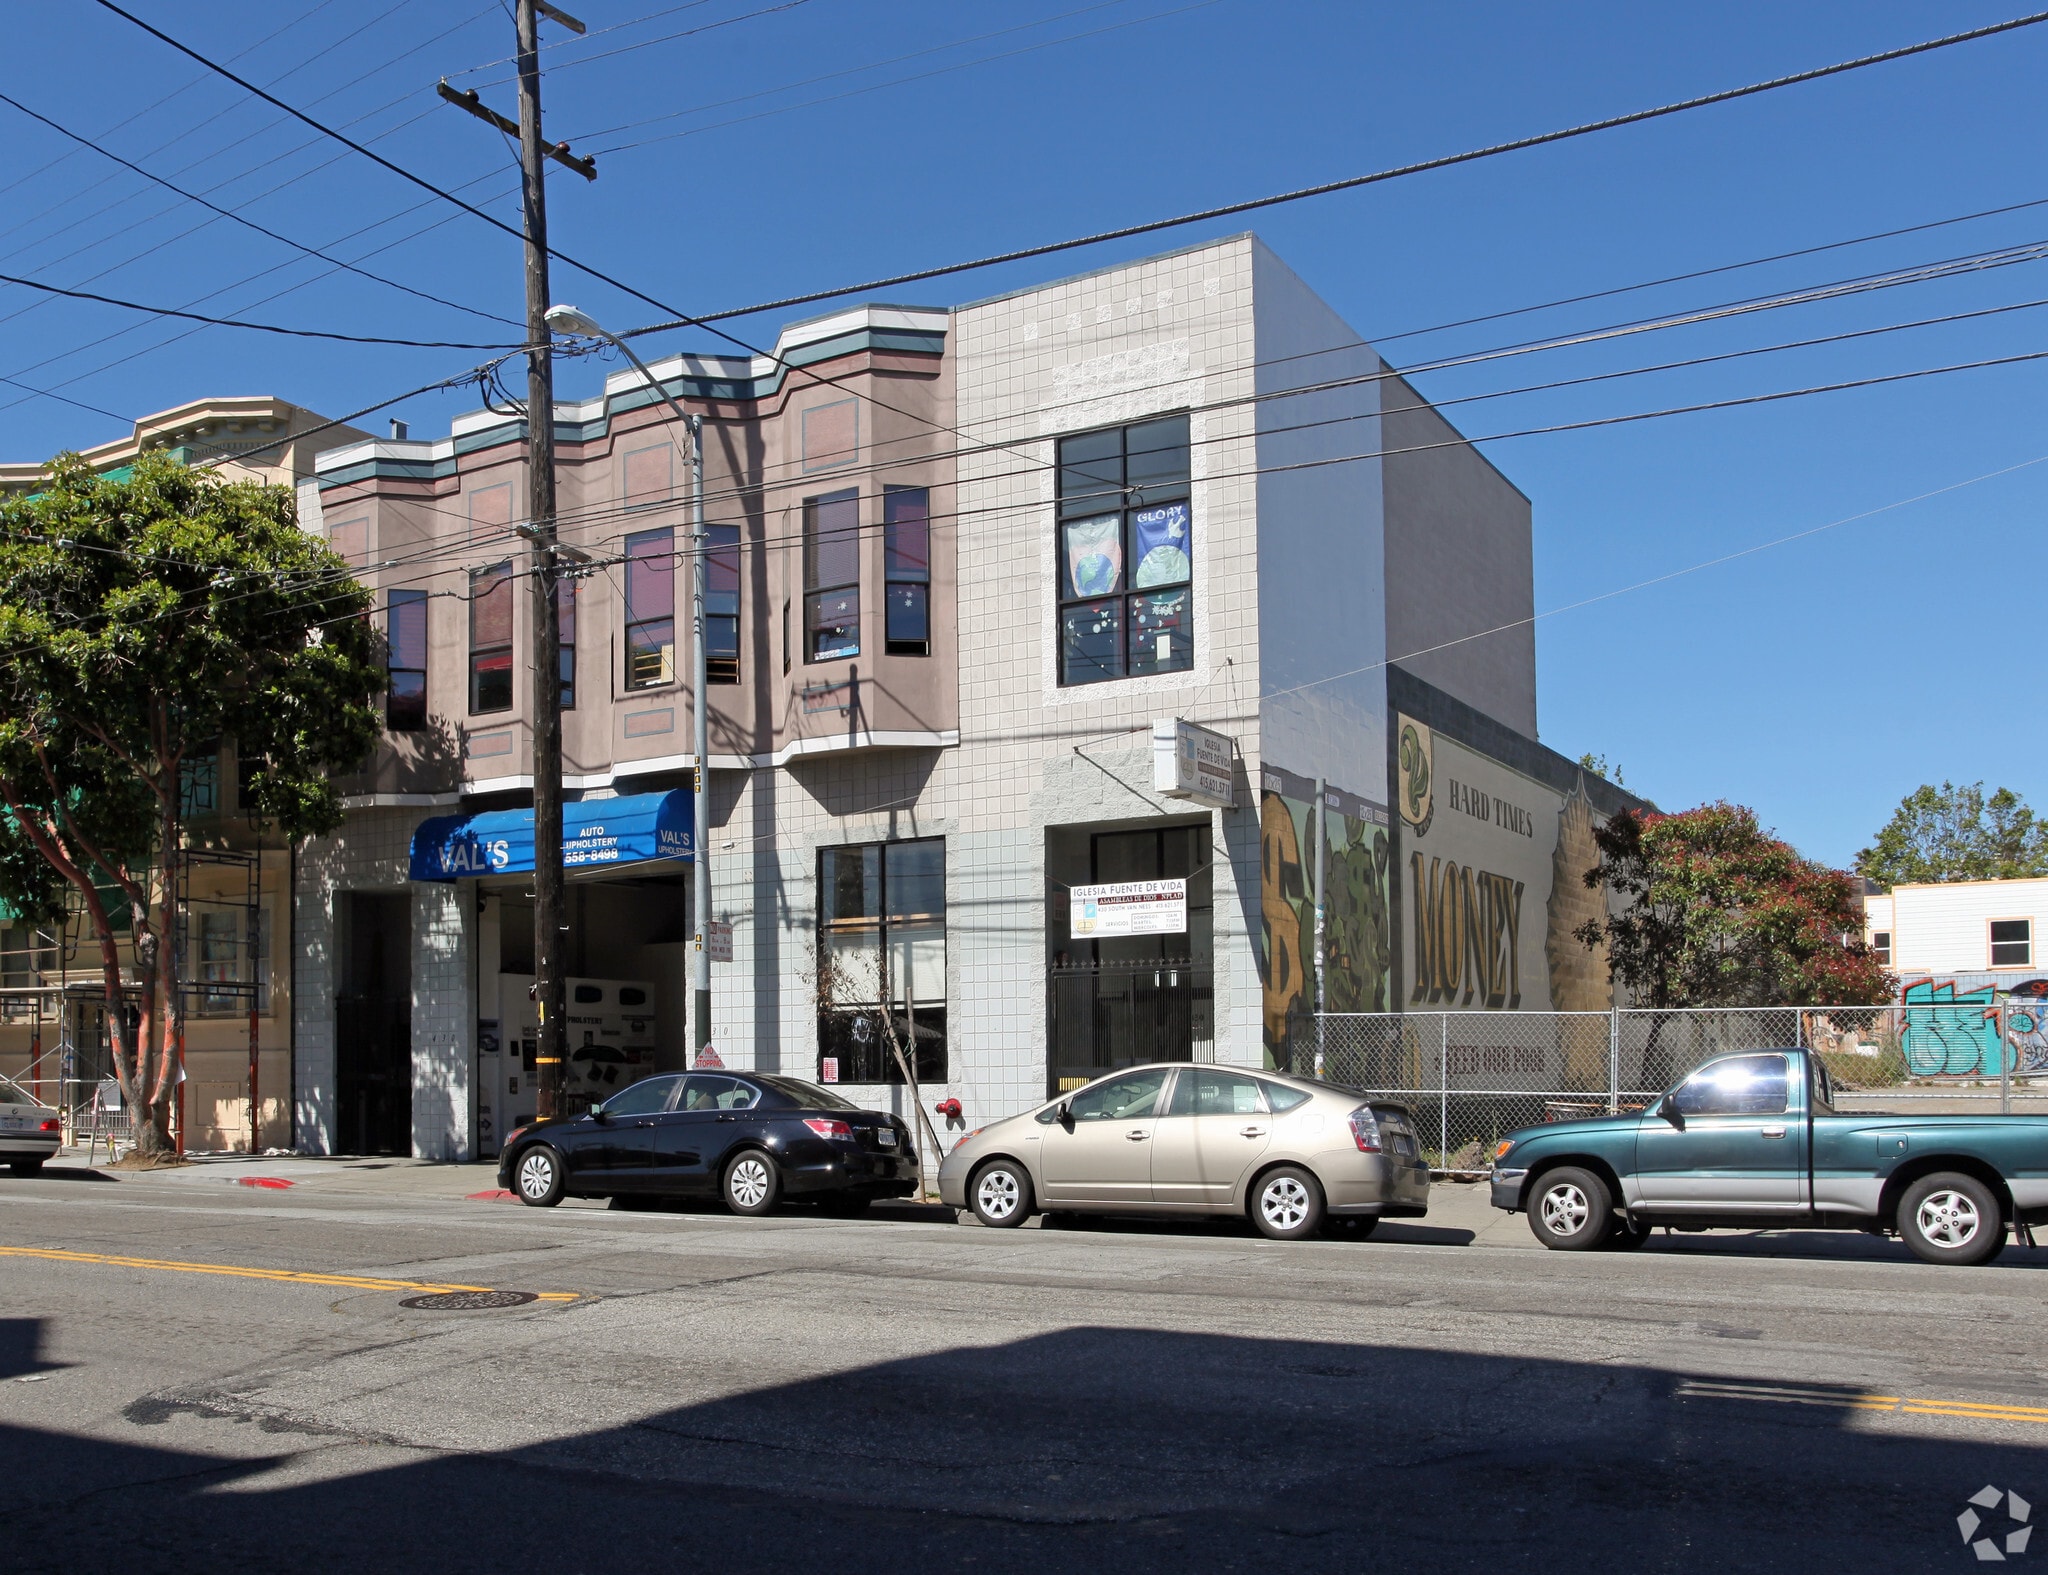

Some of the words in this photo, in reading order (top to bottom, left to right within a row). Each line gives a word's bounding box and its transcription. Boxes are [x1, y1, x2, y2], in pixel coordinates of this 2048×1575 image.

[1137, 505, 1182, 523] GLORY
[1204, 737, 1221, 752] IGLESIA
[1196, 747, 1213, 762] FUENTE
[1213, 753, 1220, 766] DE
[1220, 755, 1231, 768] VIDA
[1200, 775, 1230, 797] 415.621.5711
[1449, 779, 1490, 822] HARD
[1493, 797, 1534, 839] TIMES
[579, 826, 604, 838] AUTO
[660, 829, 690, 846] VAL'S
[566, 836, 618, 850] UPHOLSTERY
[438, 840, 509, 873] VAL'S
[565, 848, 618, 863] 558-8498
[1073, 887, 1106, 897] IGLESIA
[1110, 884, 1143, 895] FUENTE
[1146, 882, 1158, 891] DE
[1160, 881, 1183, 890] VIDA
[1099, 895, 1134, 904] ASAMBLEAS
[1409, 850, 1525, 1009] MONEY
[567, 1016, 602, 1025] PHOLSTERY
[704, 1046, 713, 1055] NO
[695, 1059, 722, 1068] STOPPING
